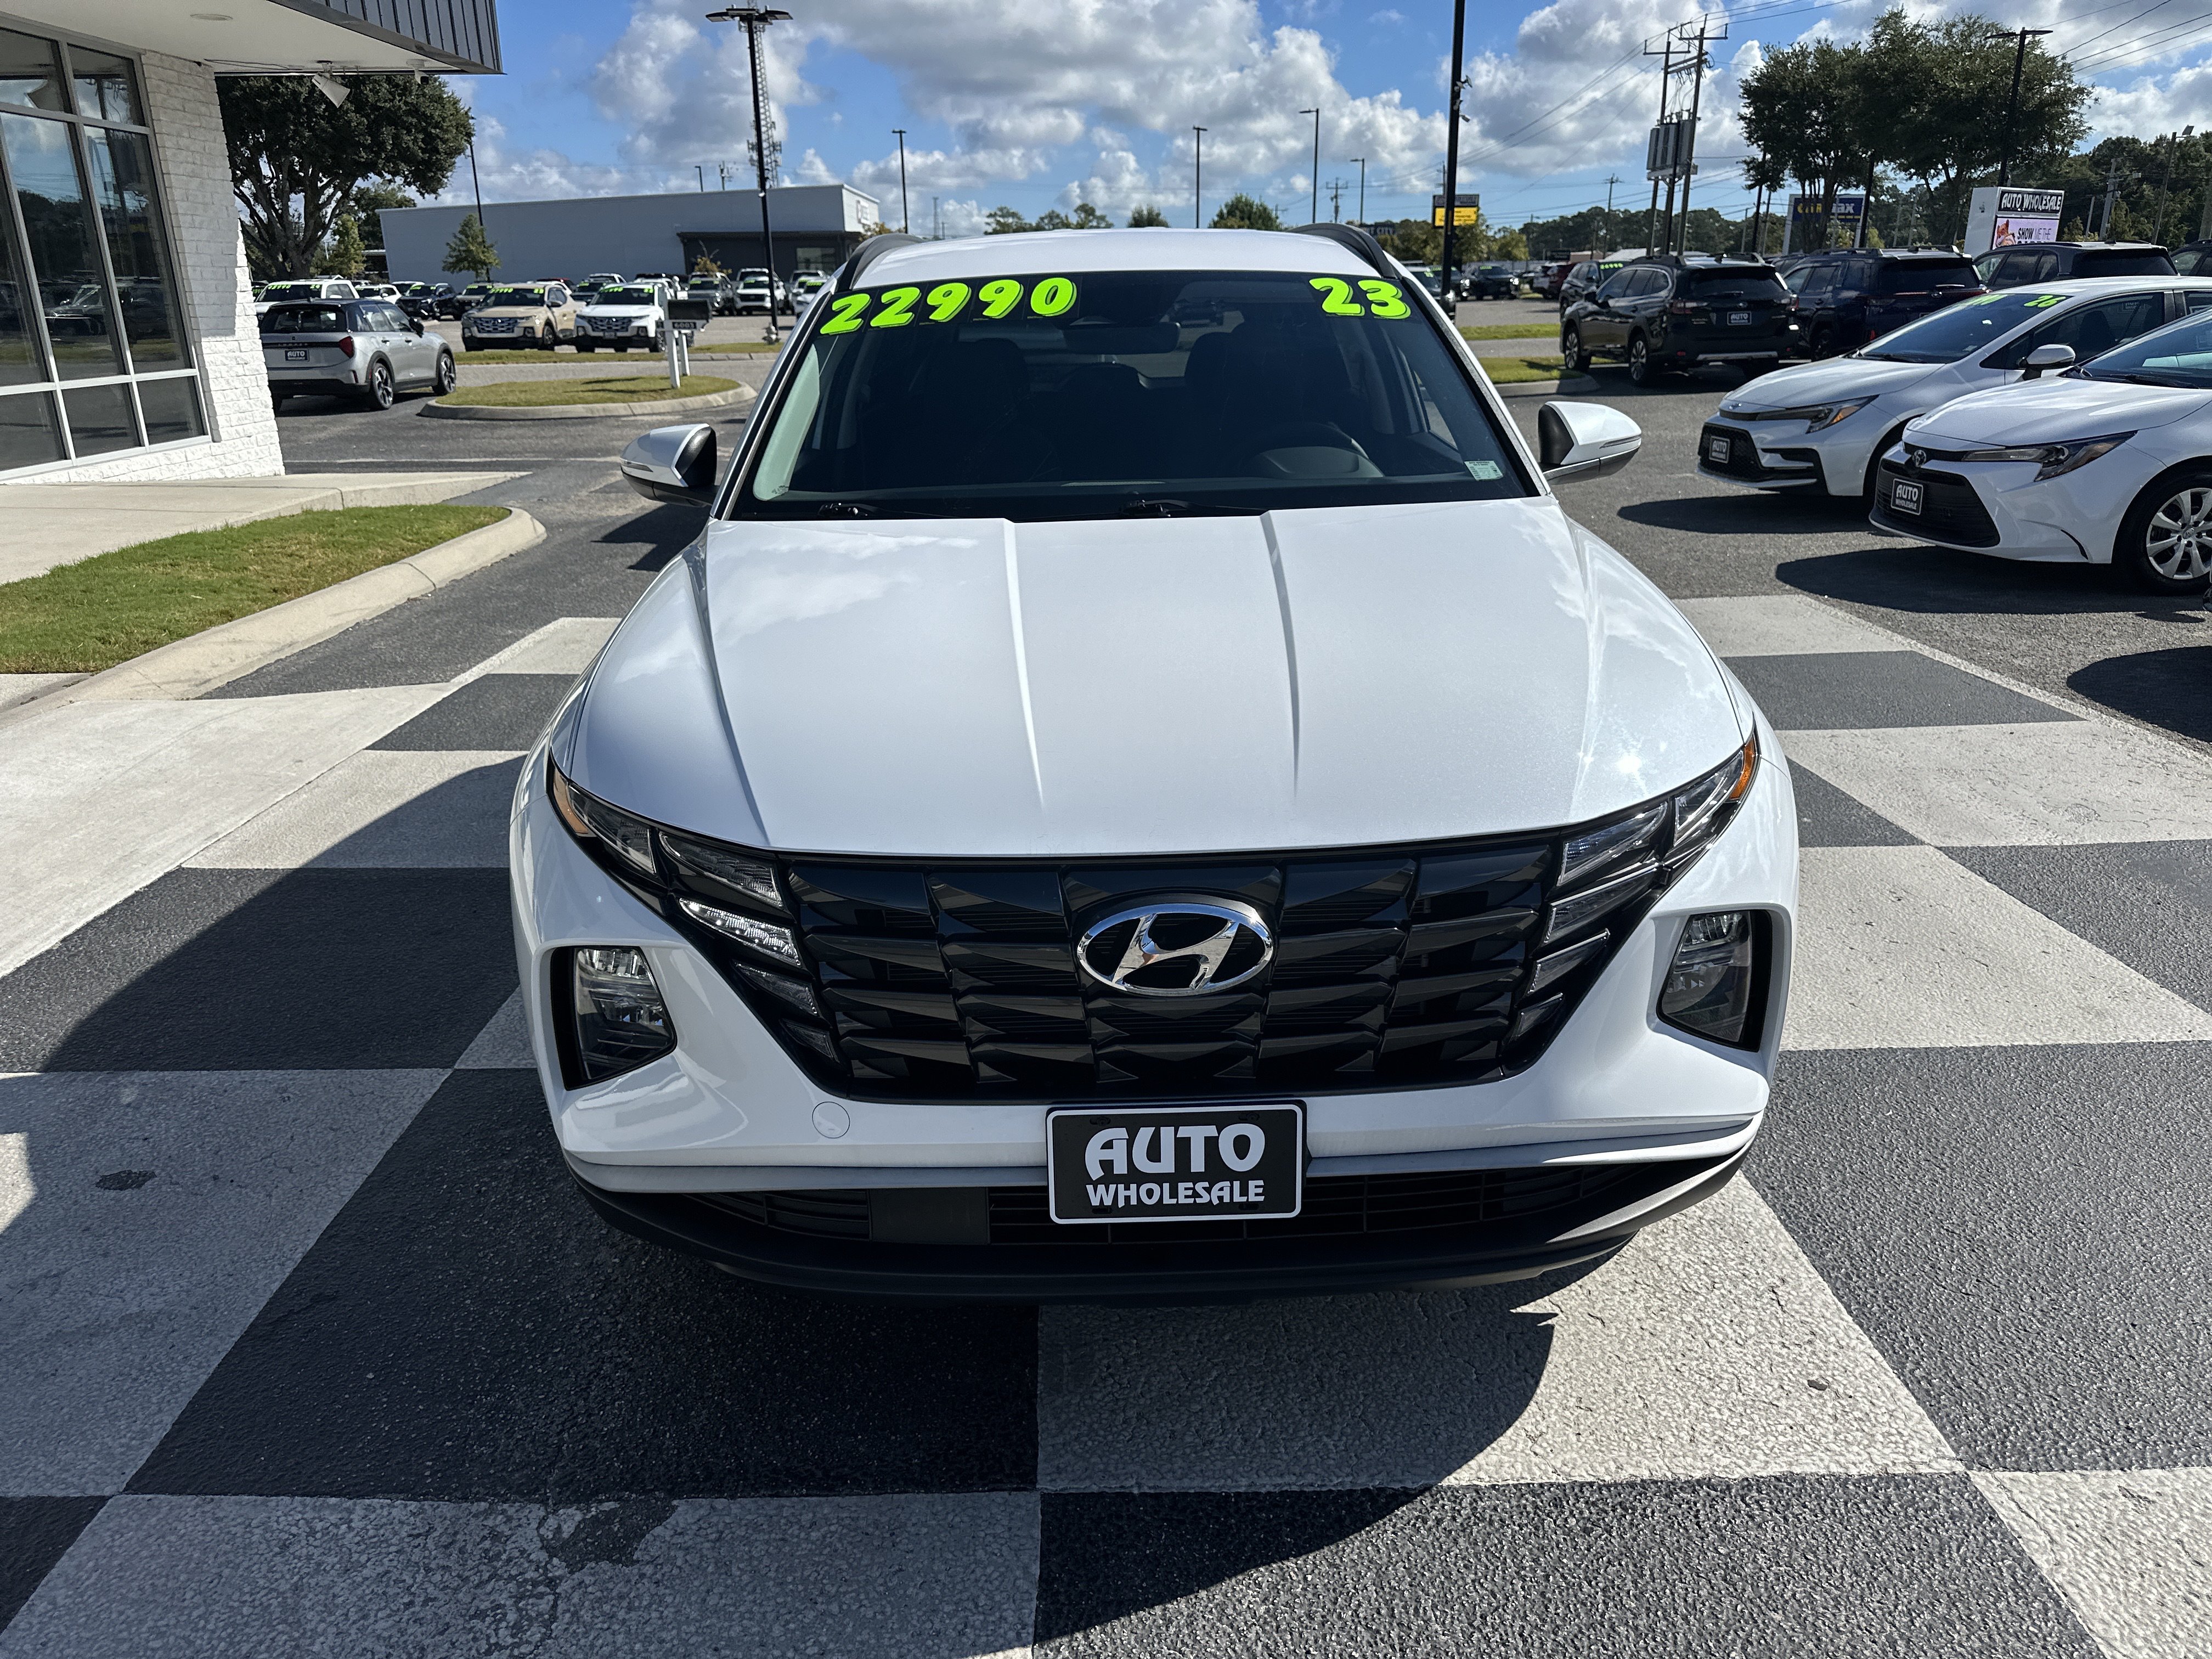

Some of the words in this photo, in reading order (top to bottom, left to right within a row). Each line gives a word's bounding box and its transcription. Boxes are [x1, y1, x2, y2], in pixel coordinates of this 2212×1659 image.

[2001, 193, 2022, 209] AUTO
[2022, 194, 2062, 211] WHOLESALE
[2017, 228, 2033, 240] SHOW
[820, 278, 1077, 335] 22990
[1309, 278, 1412, 319] 23
[2023, 295, 2067, 308] 26
[1712, 440, 1727, 453] AUTO
[1896, 484, 1918, 501] AUTO
[1085, 1123, 1265, 1181] AUTO
[1086, 1180, 1265, 1208] WHOLESALE
